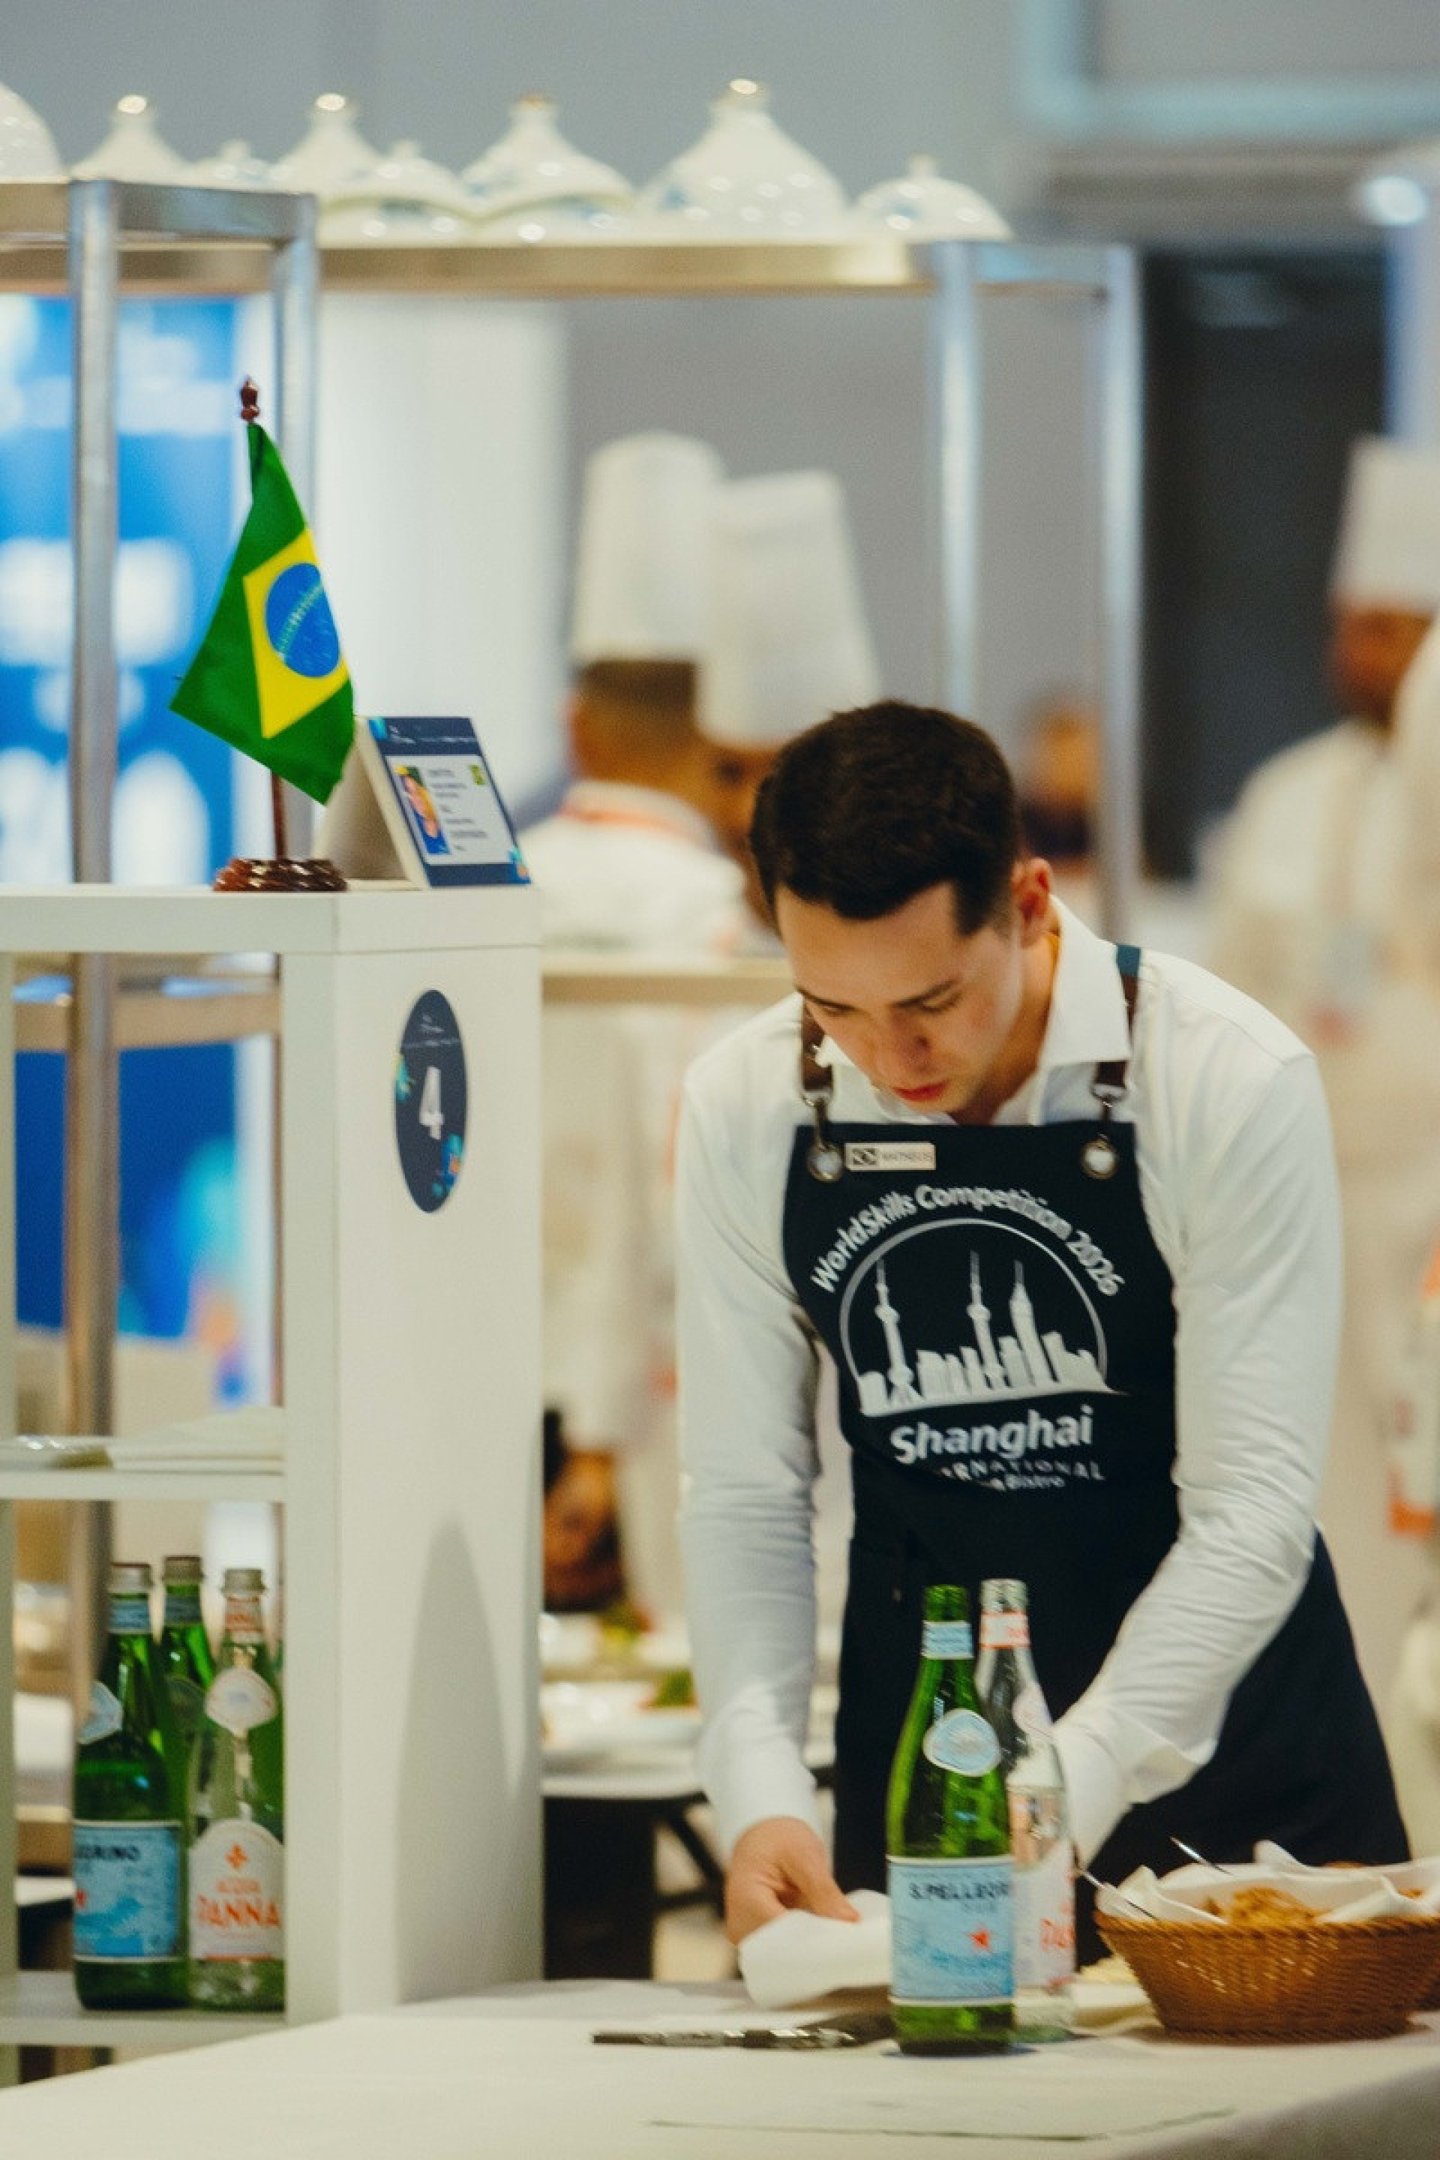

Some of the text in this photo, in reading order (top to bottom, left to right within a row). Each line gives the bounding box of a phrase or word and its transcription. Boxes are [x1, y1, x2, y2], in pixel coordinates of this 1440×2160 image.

[418, 1065, 445, 1141] 4
[810, 1184, 1126, 1296] WorldSkills Competition 2026
[890, 1403, 1094, 1465] Shanghai
